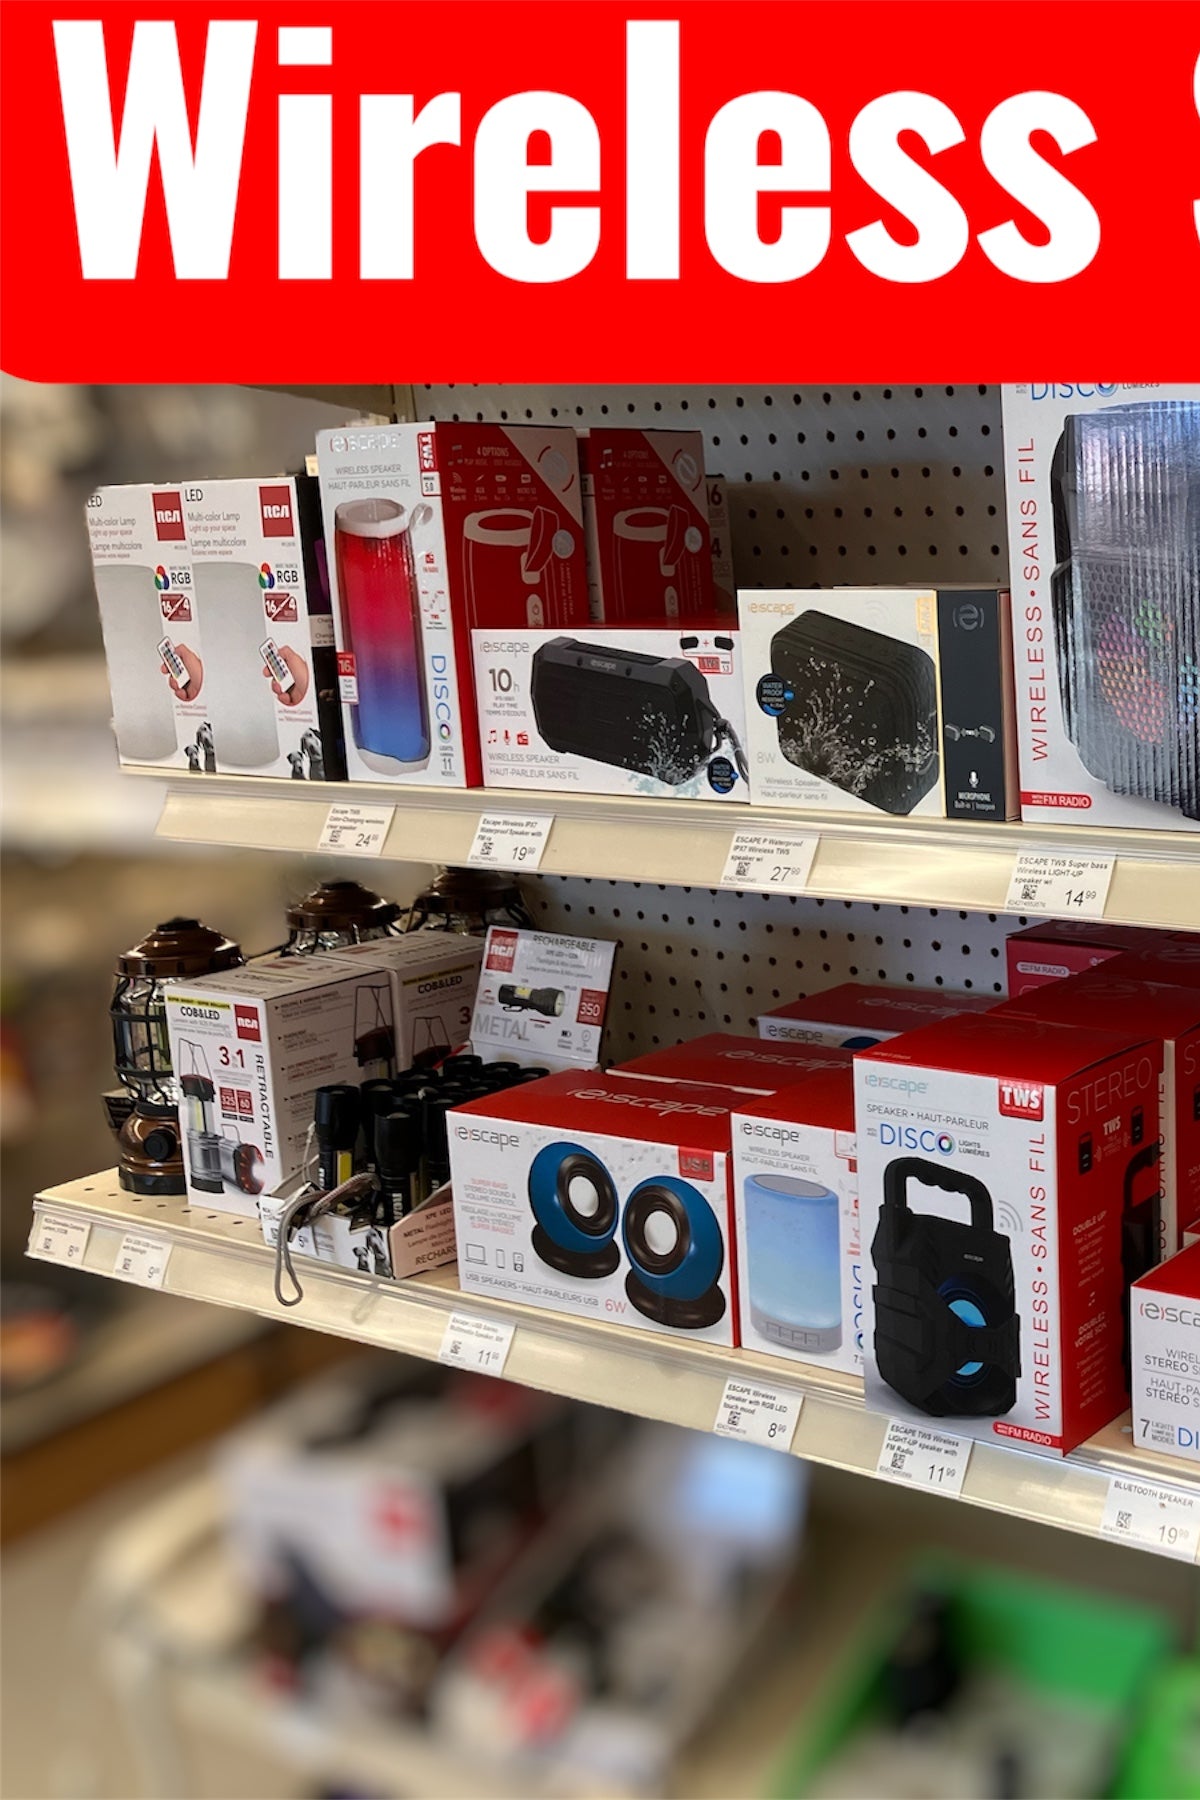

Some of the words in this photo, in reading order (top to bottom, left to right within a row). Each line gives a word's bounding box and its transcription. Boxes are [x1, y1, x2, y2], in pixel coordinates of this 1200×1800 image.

[1018, 438, 1035, 482] FIL
[336, 465, 369, 475] WIRELESS
[371, 464, 401, 473] SPEAKER
[328, 481, 379, 490] HAUT-PARLEUR
[381, 480, 399, 489] SANS
[185, 489, 203, 501] LED
[156, 510, 181, 523] RCA
[223, 512, 240, 523] Lamp
[263, 505, 289, 518] RCA
[1020, 499, 1037, 582] SANS
[171, 572, 191, 584] RGB
[277, 570, 298, 583] RGB
[1024, 606, 1048, 761] WIRELESS
[431, 656, 452, 744] DISCO
[488, 753, 524, 762] WIRELESS
[526, 754, 560, 763] SPEAKER
[489, 768, 545, 778] HAUT-PARLEUR
[547, 771, 566, 780] SANS
[568, 772, 579, 780] FIL
[765, 777, 794, 786] Wireless
[796, 778, 821, 788] Speaker
[958, 792, 991, 801] MICROPHONE
[1044, 795, 1058, 805] FM
[1059, 796, 1089, 807] RADIO
[736, 836, 761, 845] ESCAPE
[768, 838, 803, 848] Waterproof
[748, 847, 774, 855] Wireless
[1019, 857, 1048, 868] ESCAPE
[1050, 859, 1067, 867] TWS
[1068, 860, 1088, 870] Super
[1090, 861, 1108, 869] bass
[1017, 866, 1046, 876] Wireless
[1048, 869, 1083, 878] LIGHT-UP
[1014, 876, 1042, 886] speaker
[534, 934, 597, 952] RECHARGEABLE
[490, 944, 513, 958] RCA
[1042, 966, 1067, 975] RADIO
[181, 1006, 220, 1020] COB&LED
[459, 1006, 471, 1025] 3
[579, 1003, 600, 1017] 350
[237, 1017, 258, 1029] RCA
[474, 1013, 530, 1041] METAL
[1002, 1085, 1041, 1110] TWS
[1067, 1057, 1153, 1124] STEREO
[255, 1054, 274, 1160] RETRACTABLE
[867, 1103, 908, 1118] SPEAKER
[917, 1109, 988, 1131] HAUT-PARLEUR
[1103, 1116, 1121, 1135] TWS
[880, 1123, 955, 1156] DISCO
[959, 1140, 980, 1148] LIGHTS
[749, 1146, 780, 1156] WIRELESS
[782, 1151, 810, 1161] SPEAKER
[1029, 1133, 1045, 1172] FIL
[682, 1155, 710, 1172] USB
[742, 1156, 789, 1169] HAUT-PARLEUR
[790, 1164, 807, 1173] SANS
[809, 1167, 818, 1175] FIL
[1030, 1186, 1048, 1258] SANS
[1073, 1217, 1096, 1235] DOUBLE
[465, 1272, 480, 1282] USB
[481, 1275, 516, 1290] SPEAKERS
[522, 1284, 581, 1303] HAUT-PARLEURS
[583, 1296, 599, 1306] USB
[605, 1300, 627, 1314] 6W
[1033, 1277, 1050, 1422] WIRELESS
[1145, 1355, 1189, 1372] STEREO
[728, 1384, 751, 1396] ESCAPE
[753, 1390, 776, 1401] Wireless
[1146, 1387, 1189, 1405] STÉRÉO
[761, 1401, 774, 1410] RGB
[775, 1404, 787, 1413] LED
[891, 1425, 916, 1437] ESCAPE
[917, 1430, 931, 1439] TWS
[1140, 1418, 1150, 1438] 7
[1151, 1421, 1174, 1431] LIGHTS
[1008, 1426, 1022, 1438] FM
[1023, 1429, 1051, 1445] RADIO
[1151, 1435, 1175, 1446] MODES
[1114, 1480, 1157, 1497] BLUETOOTH
[1158, 1492, 1194, 1507] SPEAKER
